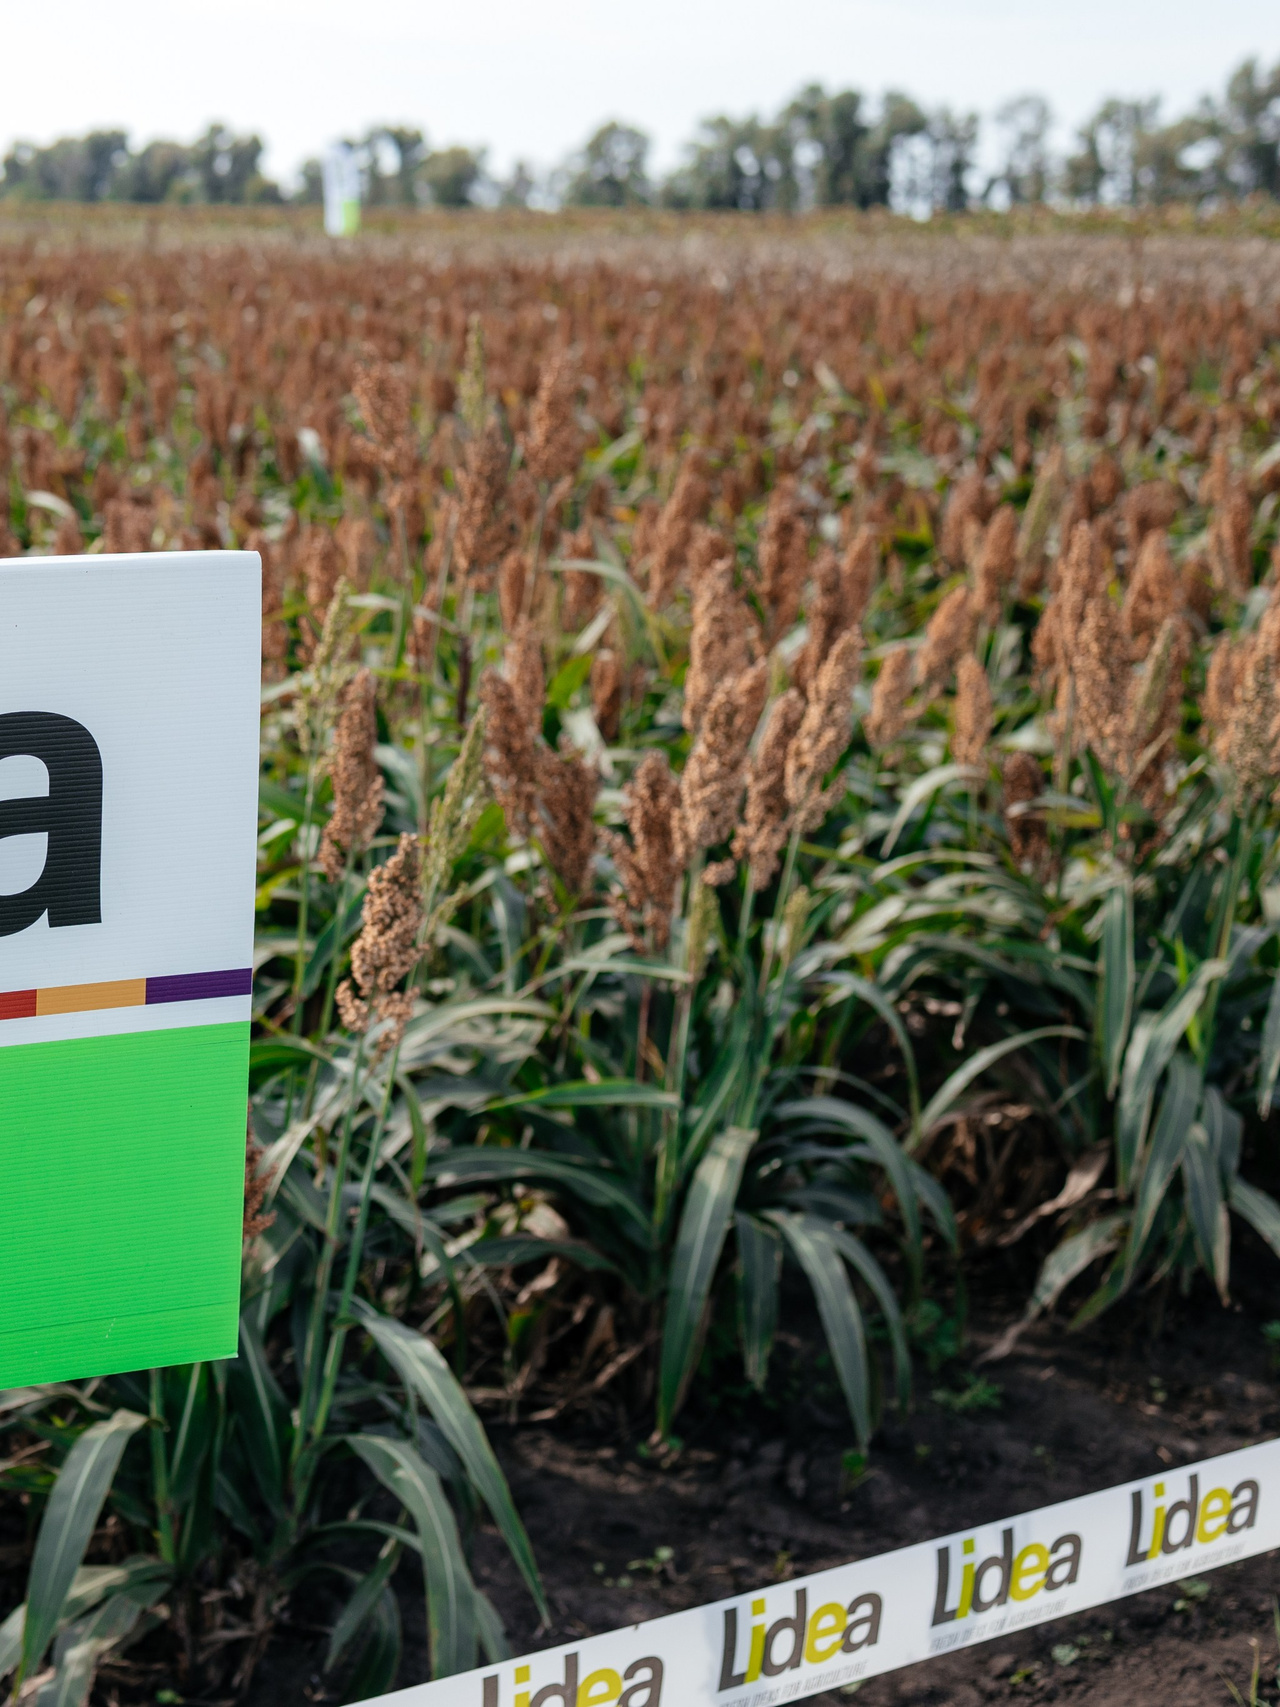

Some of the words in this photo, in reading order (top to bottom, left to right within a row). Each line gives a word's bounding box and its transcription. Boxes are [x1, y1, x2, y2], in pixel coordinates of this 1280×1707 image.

[1126, 1474, 1260, 1567] Lidea
[931, 1528, 1082, 1627] Lidea
[718, 1587, 883, 1692] Lidea
